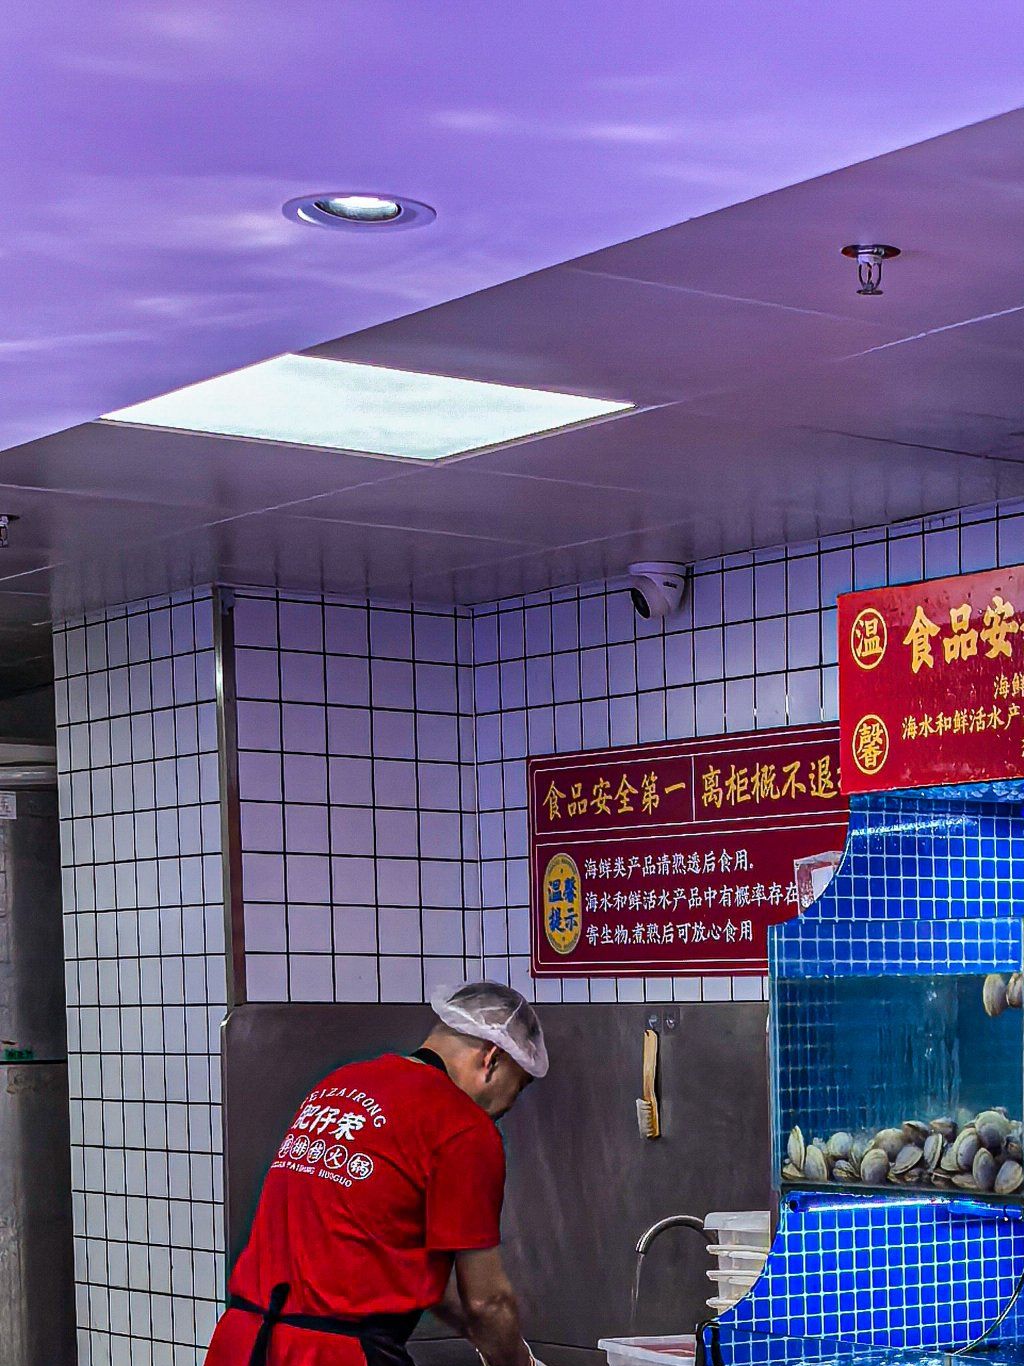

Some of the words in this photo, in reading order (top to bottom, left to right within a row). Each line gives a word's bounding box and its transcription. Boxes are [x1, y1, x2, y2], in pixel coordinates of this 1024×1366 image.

[542, 771, 687, 821] 食品安全第一
[701, 755, 842, 808] 离柜概不退
